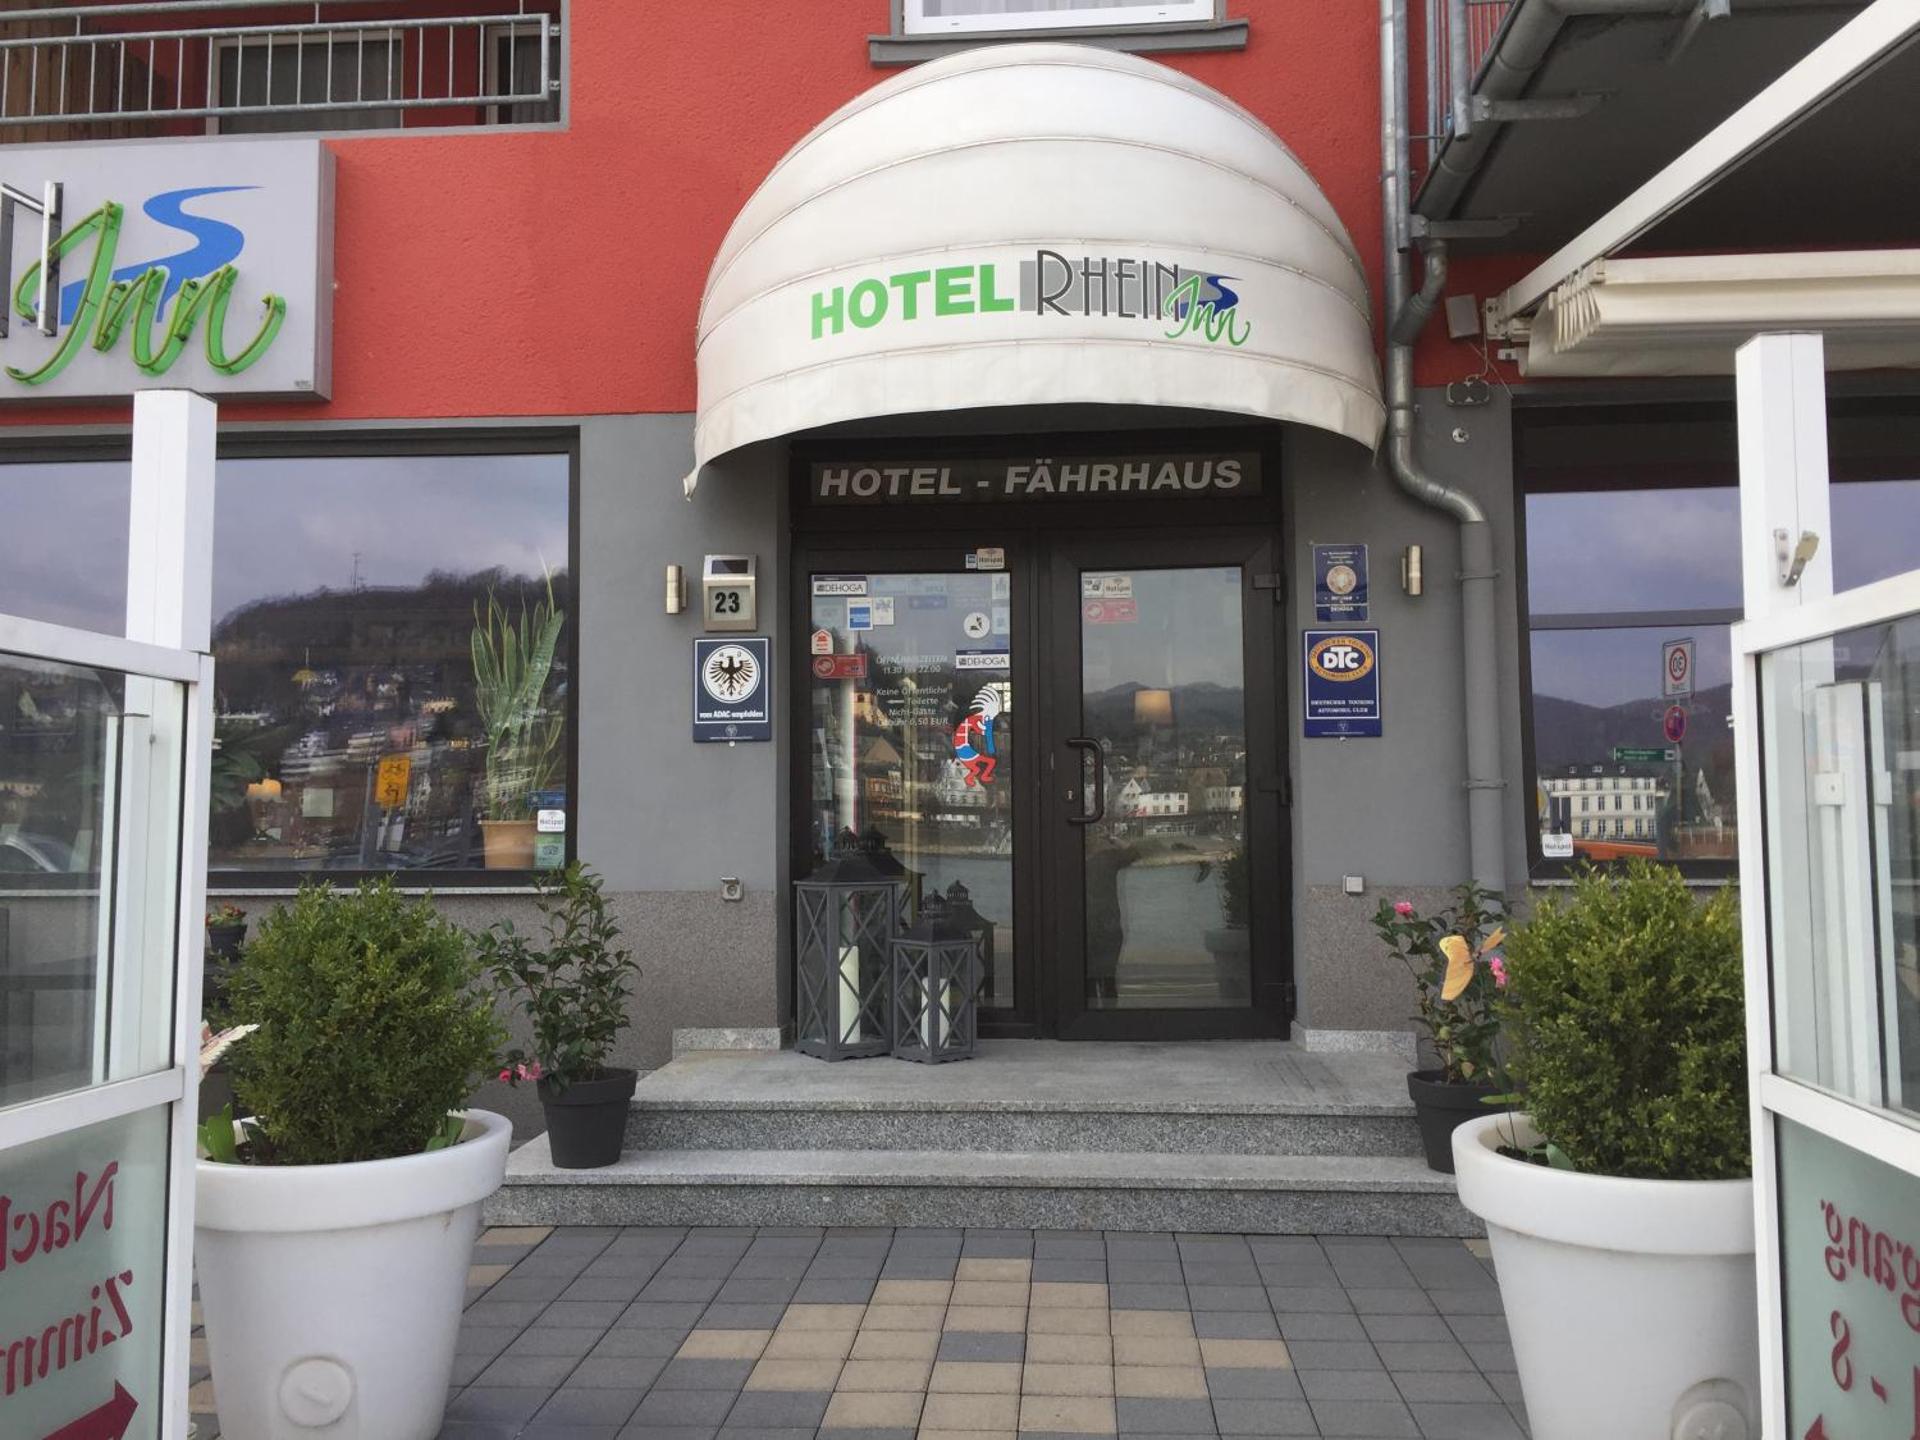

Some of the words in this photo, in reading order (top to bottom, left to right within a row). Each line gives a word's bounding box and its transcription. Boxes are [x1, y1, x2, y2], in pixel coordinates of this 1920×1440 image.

[2, 199, 286, 386] Inn
[811, 264, 1014, 340] HOTEL
[1037, 250, 1179, 322] RHEIN
[1164, 275, 1250, 346] Inn
[820, 467, 962, 497] HOTEL
[1005, 459, 1242, 494] FÄHRHAUS
[825, 584, 864, 593] DEHOGA
[715, 592, 740, 613] 23
[967, 657, 1006, 666] DEHOGA
[1323, 646, 1360, 669] DTC
[876, 687, 900, 696] Keine
[713, 710, 731, 719] ADAC
